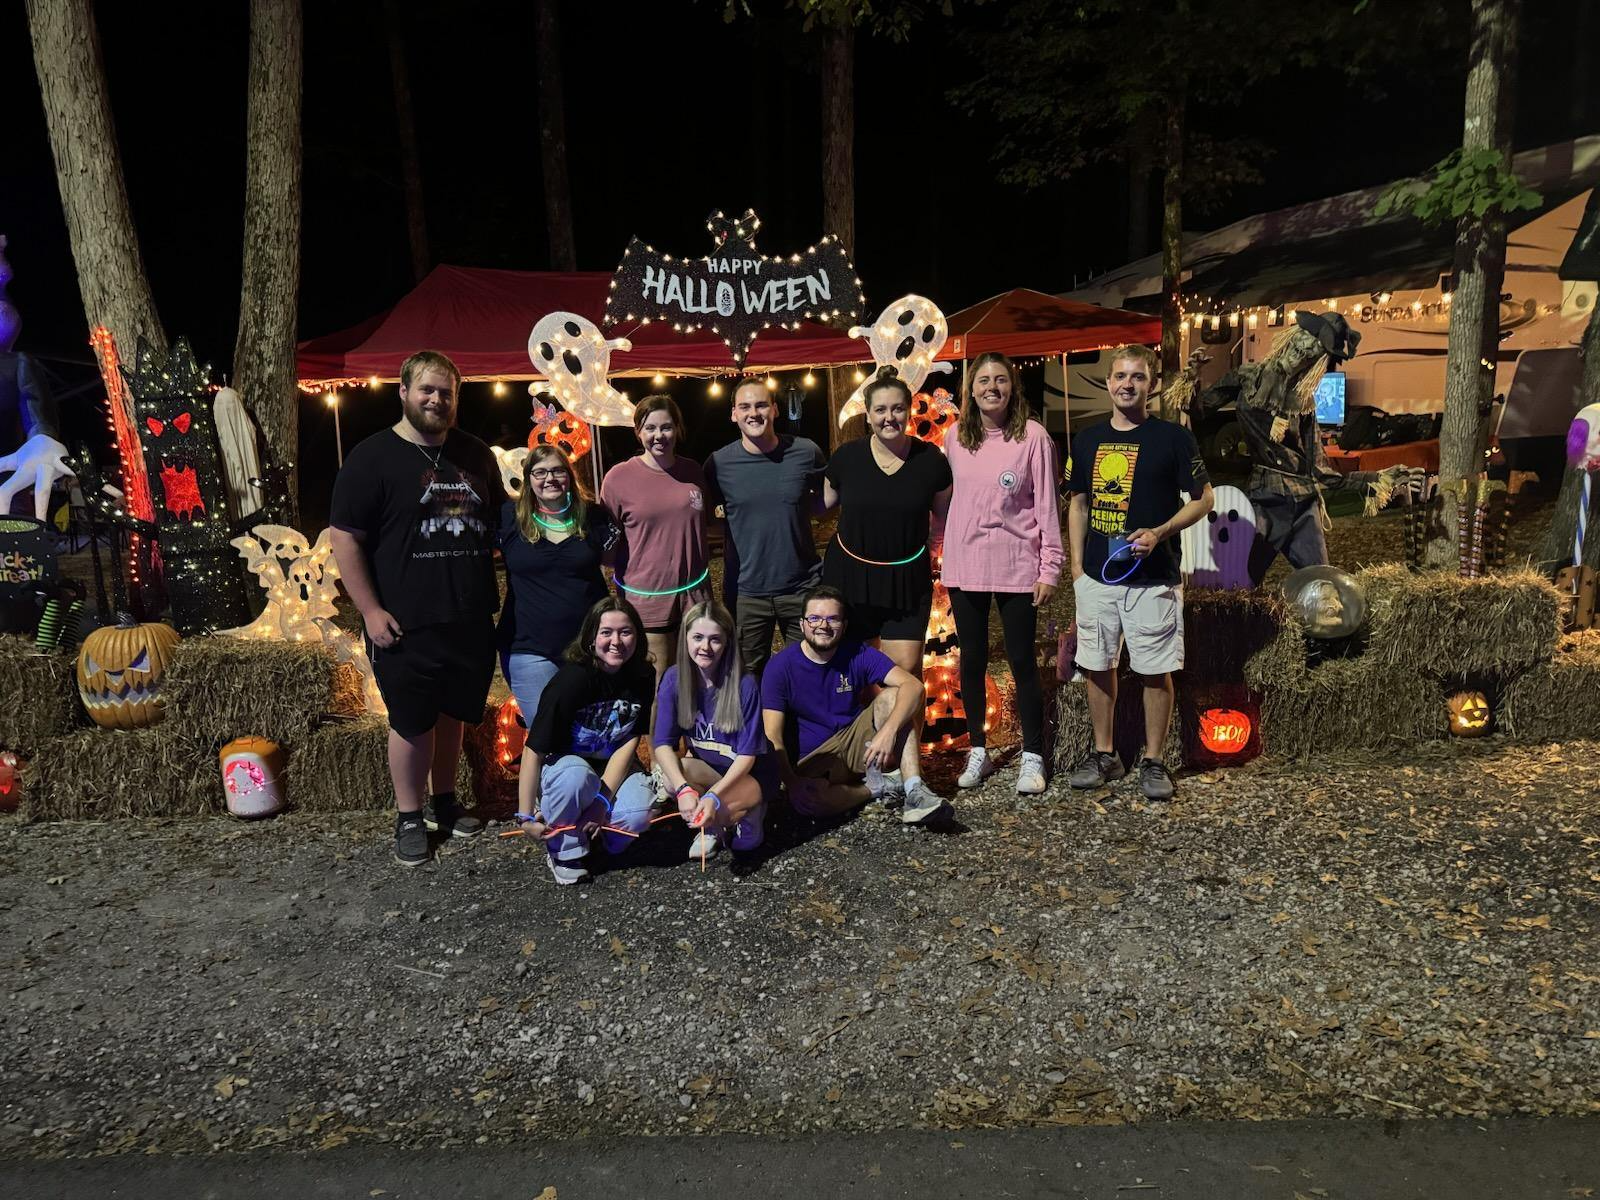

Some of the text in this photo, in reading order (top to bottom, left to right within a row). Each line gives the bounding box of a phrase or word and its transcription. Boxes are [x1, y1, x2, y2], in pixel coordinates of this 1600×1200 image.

[706, 257, 763, 275] HAPPY
[641, 264, 832, 317] HALLOWEEN
[419, 478, 483, 504] METALLICA
[1091, 509, 1126, 522] PEEING
[1091, 519, 1125, 534] OUTSIDE
[1212, 725, 1247, 743] BOO
